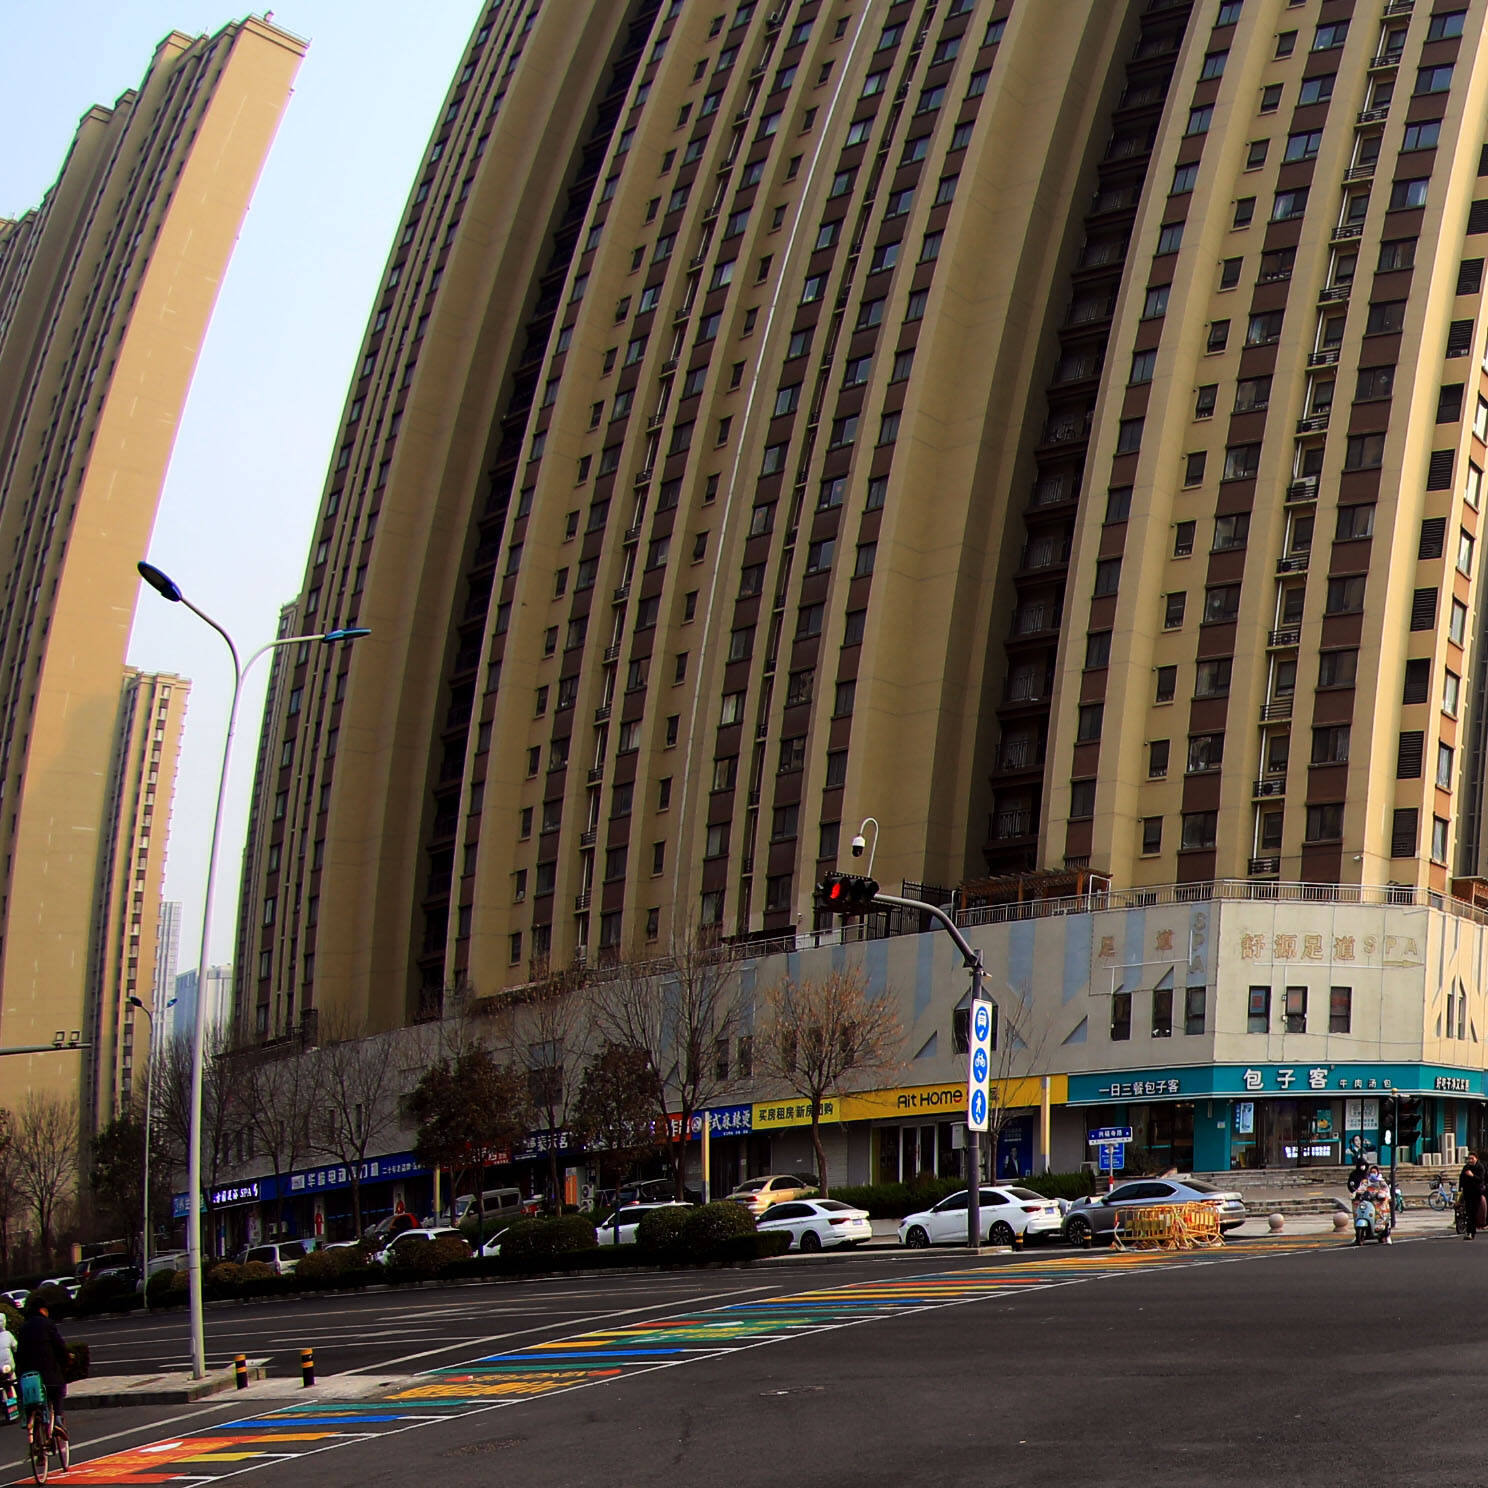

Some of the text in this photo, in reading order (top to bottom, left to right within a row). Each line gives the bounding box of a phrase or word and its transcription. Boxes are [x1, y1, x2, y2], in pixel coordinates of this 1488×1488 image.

[1098, 1078, 1180, 1097] 一日三餐包子客
[1243, 1067, 1330, 1091] 包子客
[1338, 1078, 1393, 1090] 牛肉汤包
